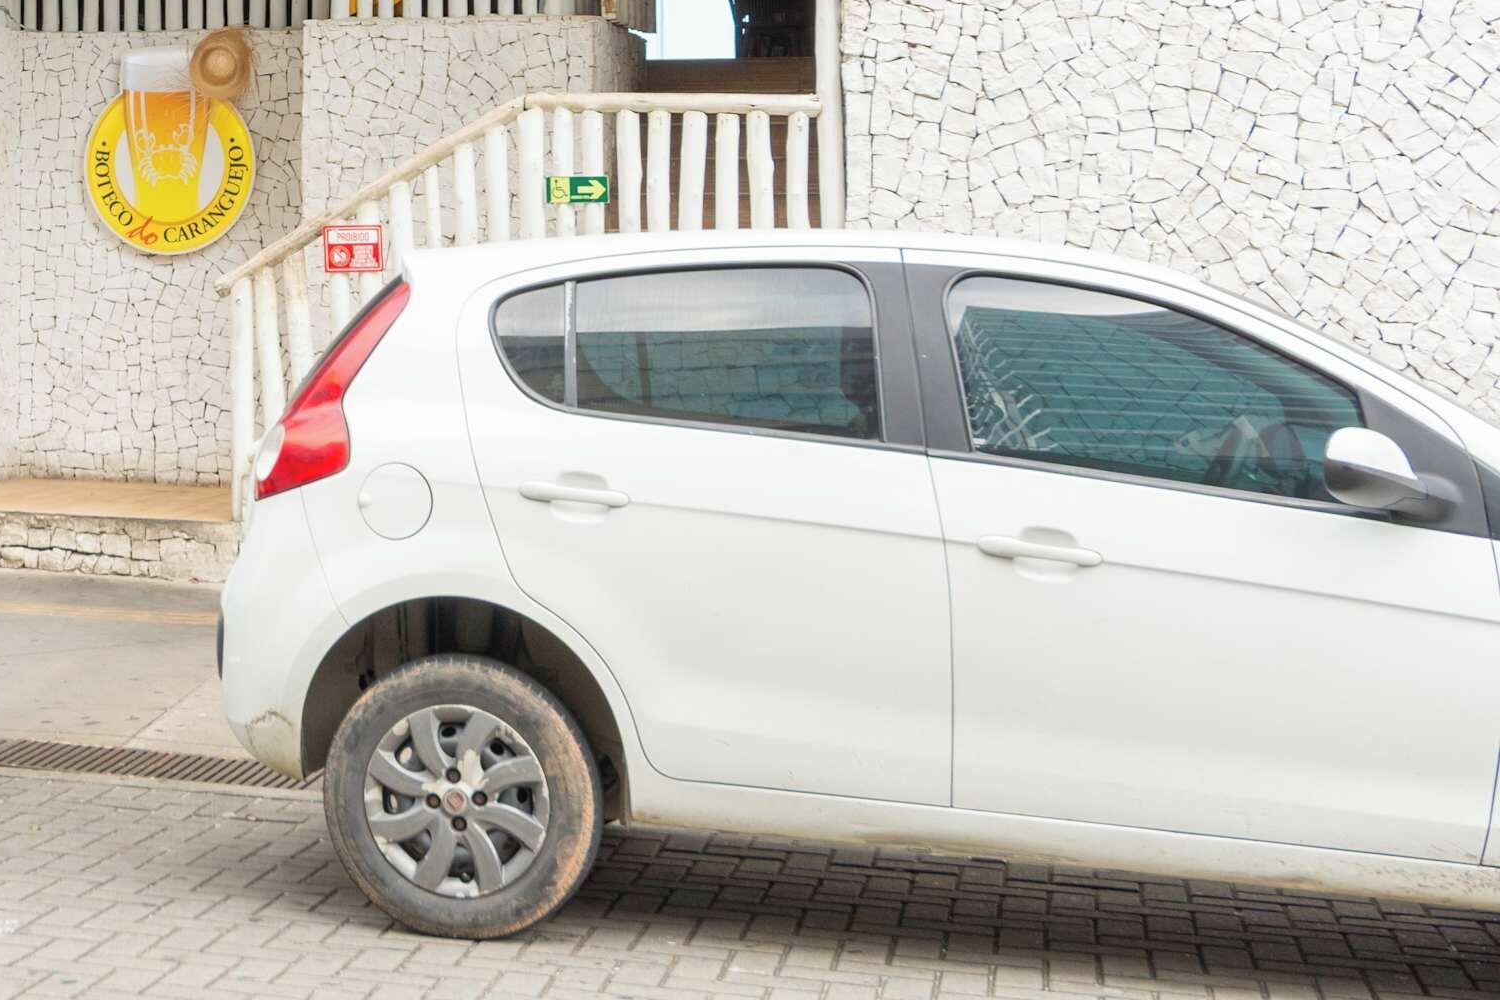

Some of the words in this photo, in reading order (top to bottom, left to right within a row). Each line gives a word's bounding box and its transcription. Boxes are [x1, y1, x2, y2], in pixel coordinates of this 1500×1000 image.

[94, 150, 133, 227] BOTECO
[127, 215, 159, 246] do
[163, 145, 249, 244] CARANGUEJO
[336, 231, 370, 242] PROIBIDO
